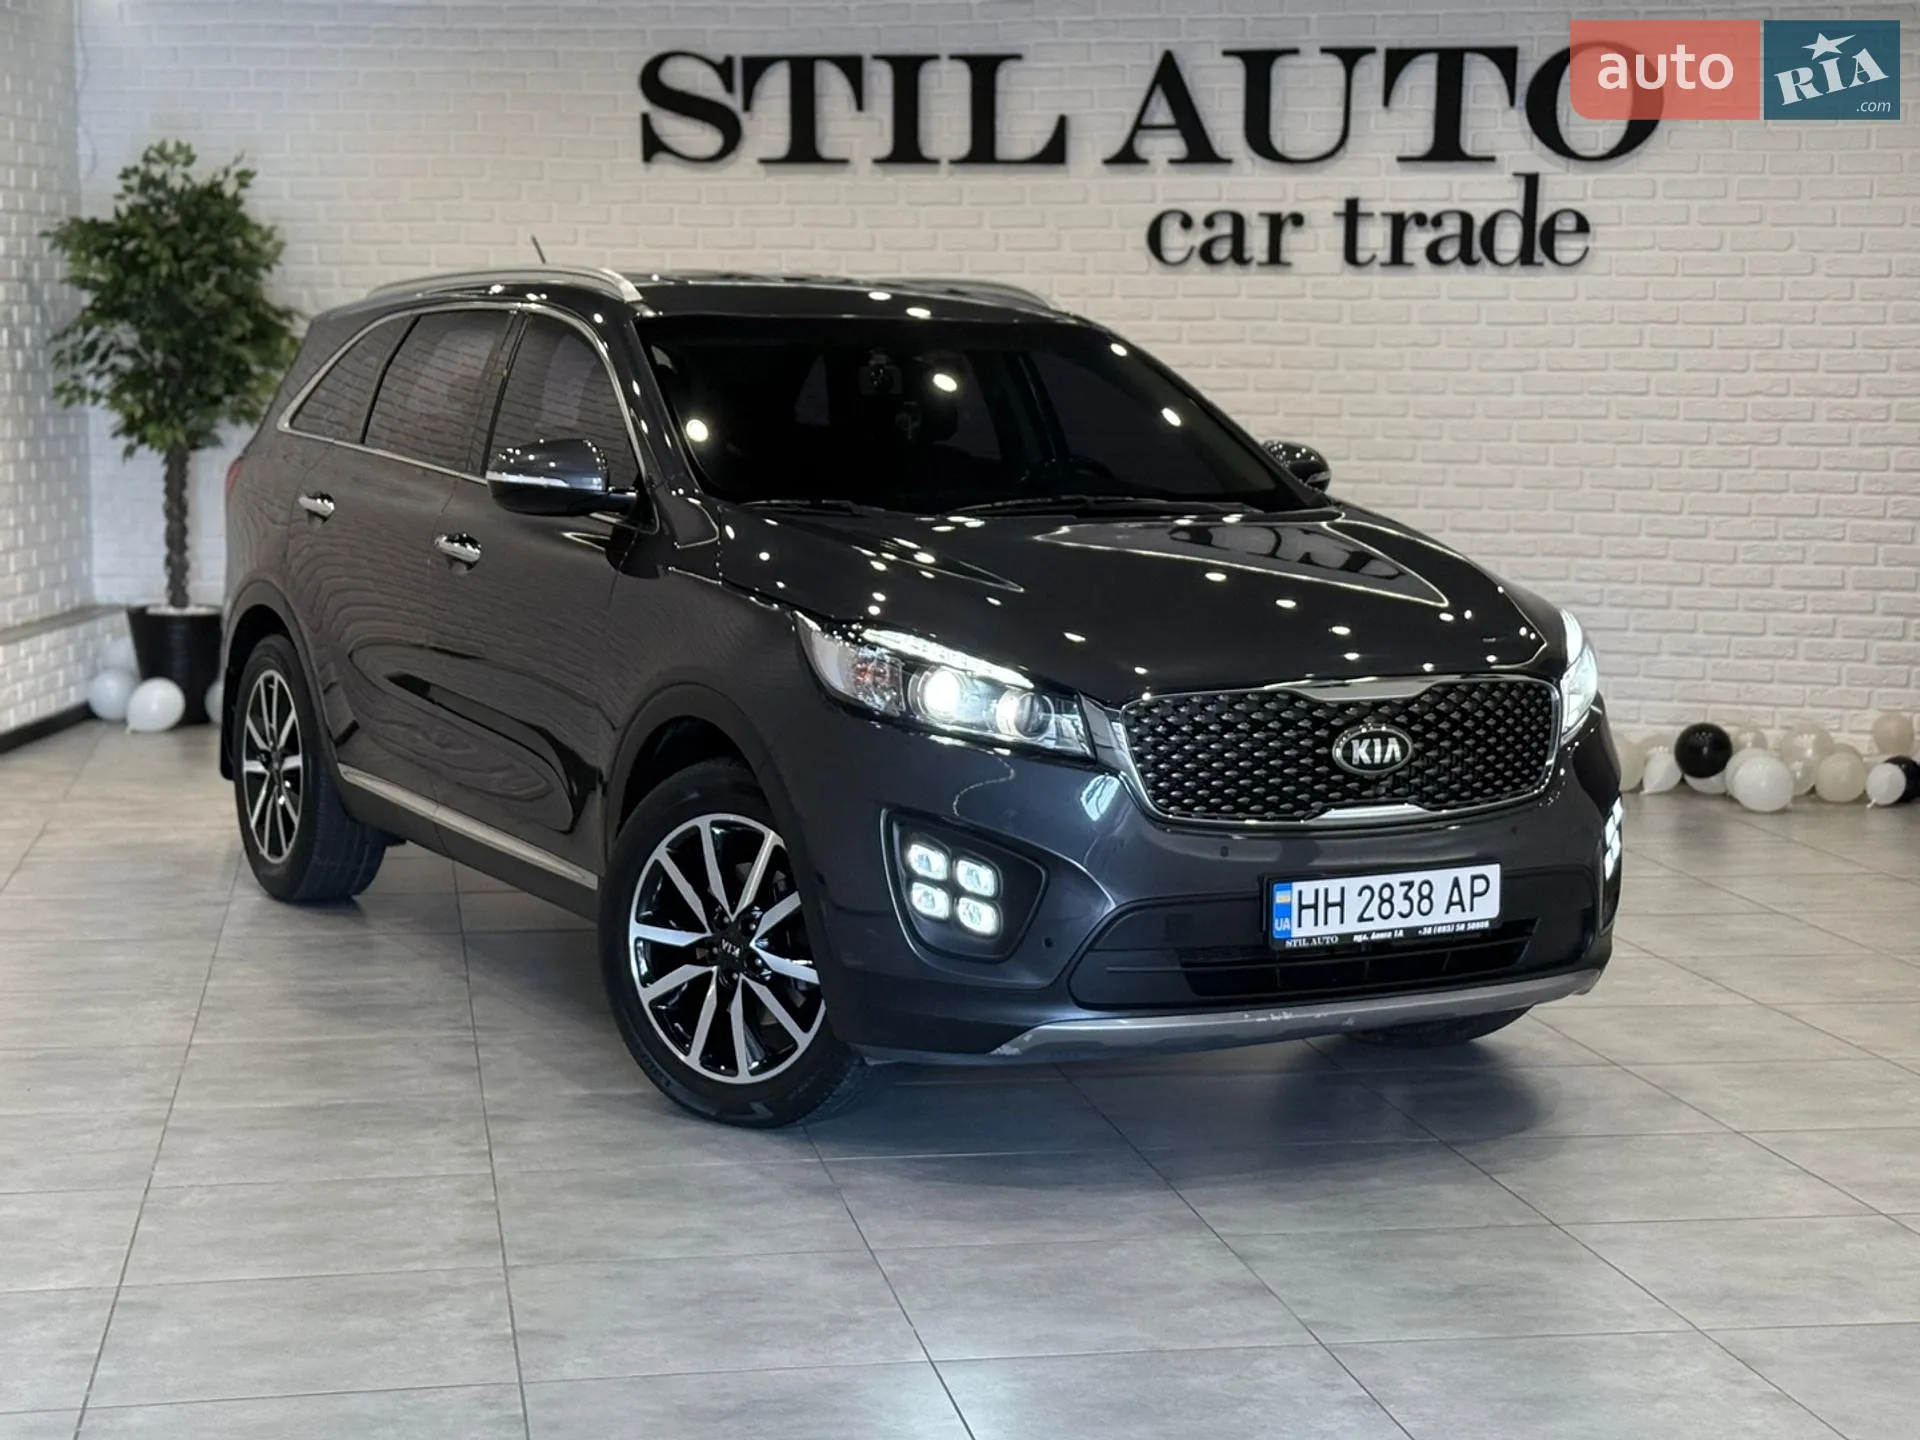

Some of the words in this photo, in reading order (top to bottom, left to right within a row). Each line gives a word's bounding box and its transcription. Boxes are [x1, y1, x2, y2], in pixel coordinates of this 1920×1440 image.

[639, 50, 1067, 164] STIL
[1102, 40, 1664, 164] AUTO
[1147, 206, 1304, 268] car
[1334, 172, 1590, 268] trade
[1351, 737, 1401, 765] KIA
[1297, 885, 1346, 928] HH
[1356, 878, 1434, 923] 2838
[1444, 873, 1491, 914] AP
[1274, 917, 1290, 931] UA
[1311, 935, 1339, 946] AUTO
